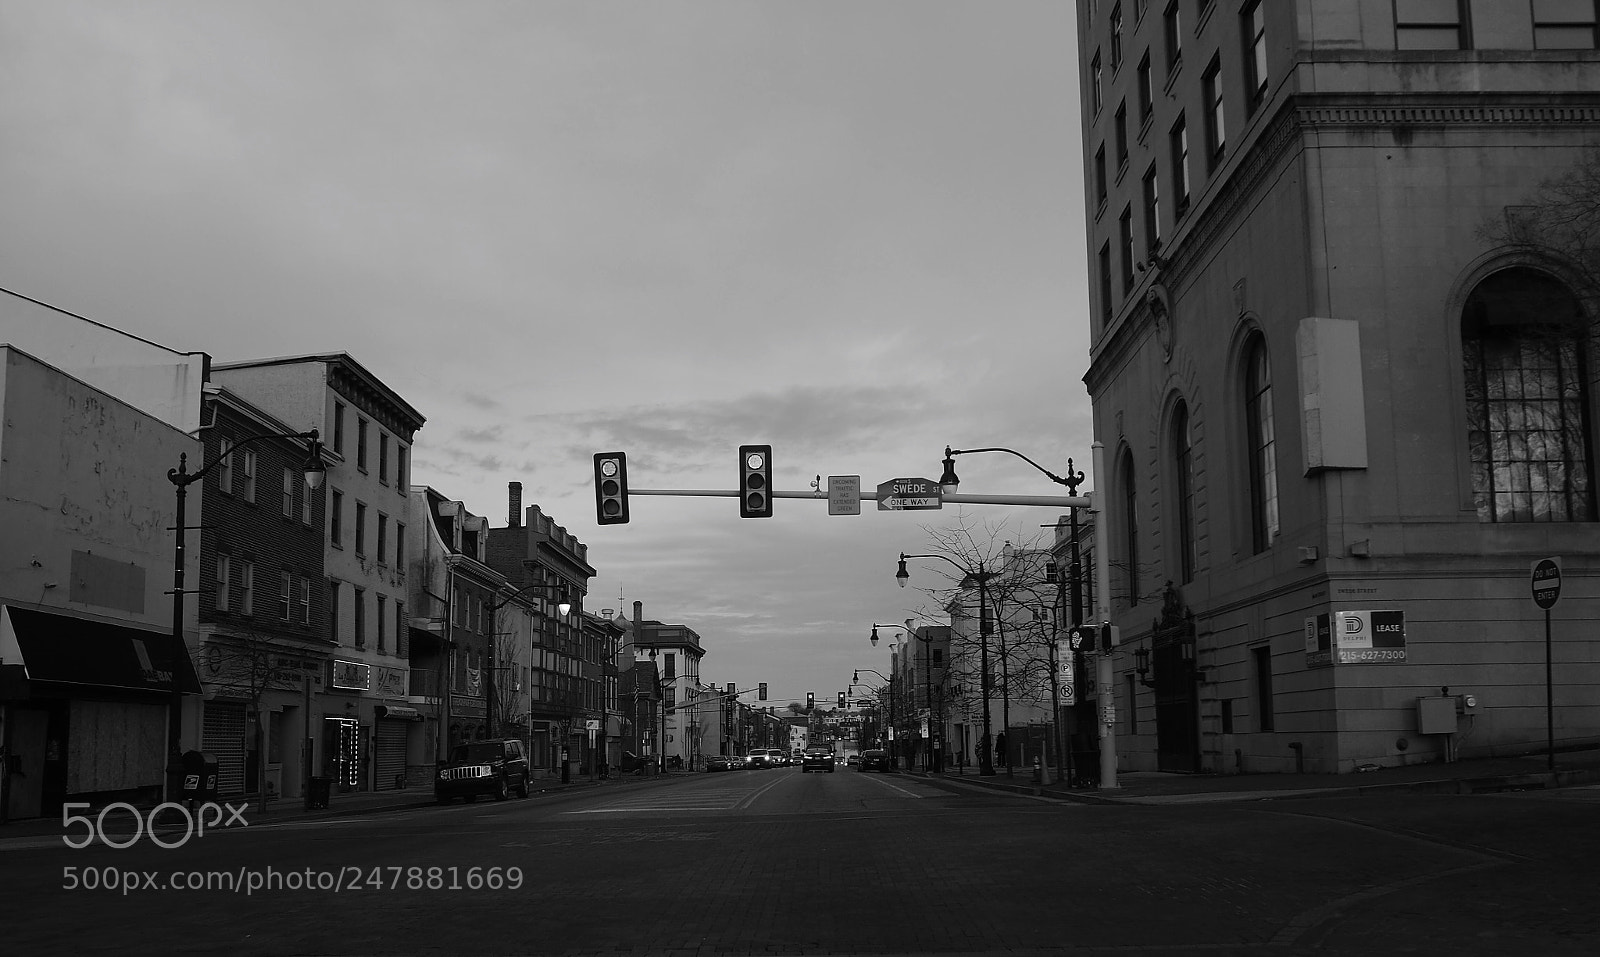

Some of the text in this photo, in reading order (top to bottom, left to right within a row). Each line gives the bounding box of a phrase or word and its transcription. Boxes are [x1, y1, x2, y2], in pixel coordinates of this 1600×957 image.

[893, 484, 926, 494] SWEDE
[1535, 567, 1557, 578] DO NOT
[1537, 590, 1556, 601] ENTER
[1376, 624, 1400, 632] LEASE
[1341, 650, 1405, 660] 215-627-7300
